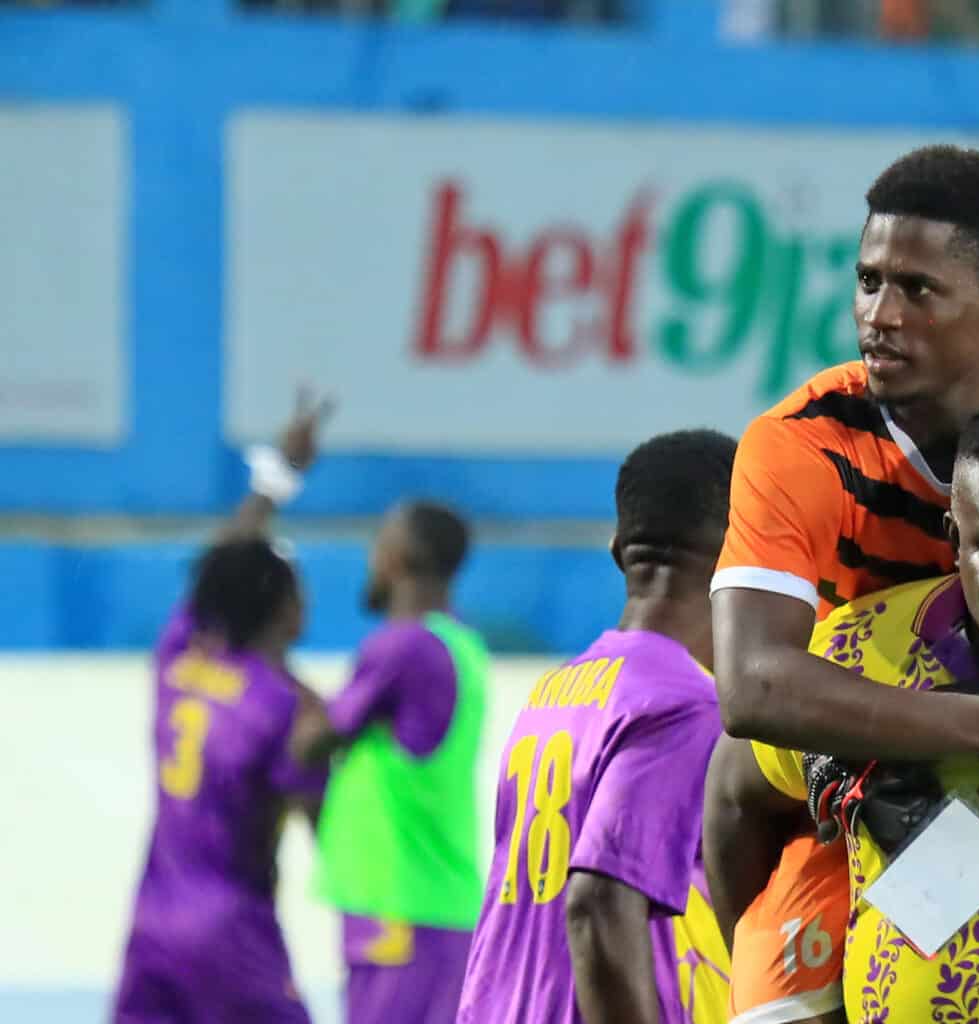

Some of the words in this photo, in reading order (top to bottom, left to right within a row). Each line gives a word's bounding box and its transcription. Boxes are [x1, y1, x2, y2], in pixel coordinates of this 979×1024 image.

[159, 698, 208, 798] 3
[500, 729, 573, 905] 18
[779, 913, 833, 975] 16
